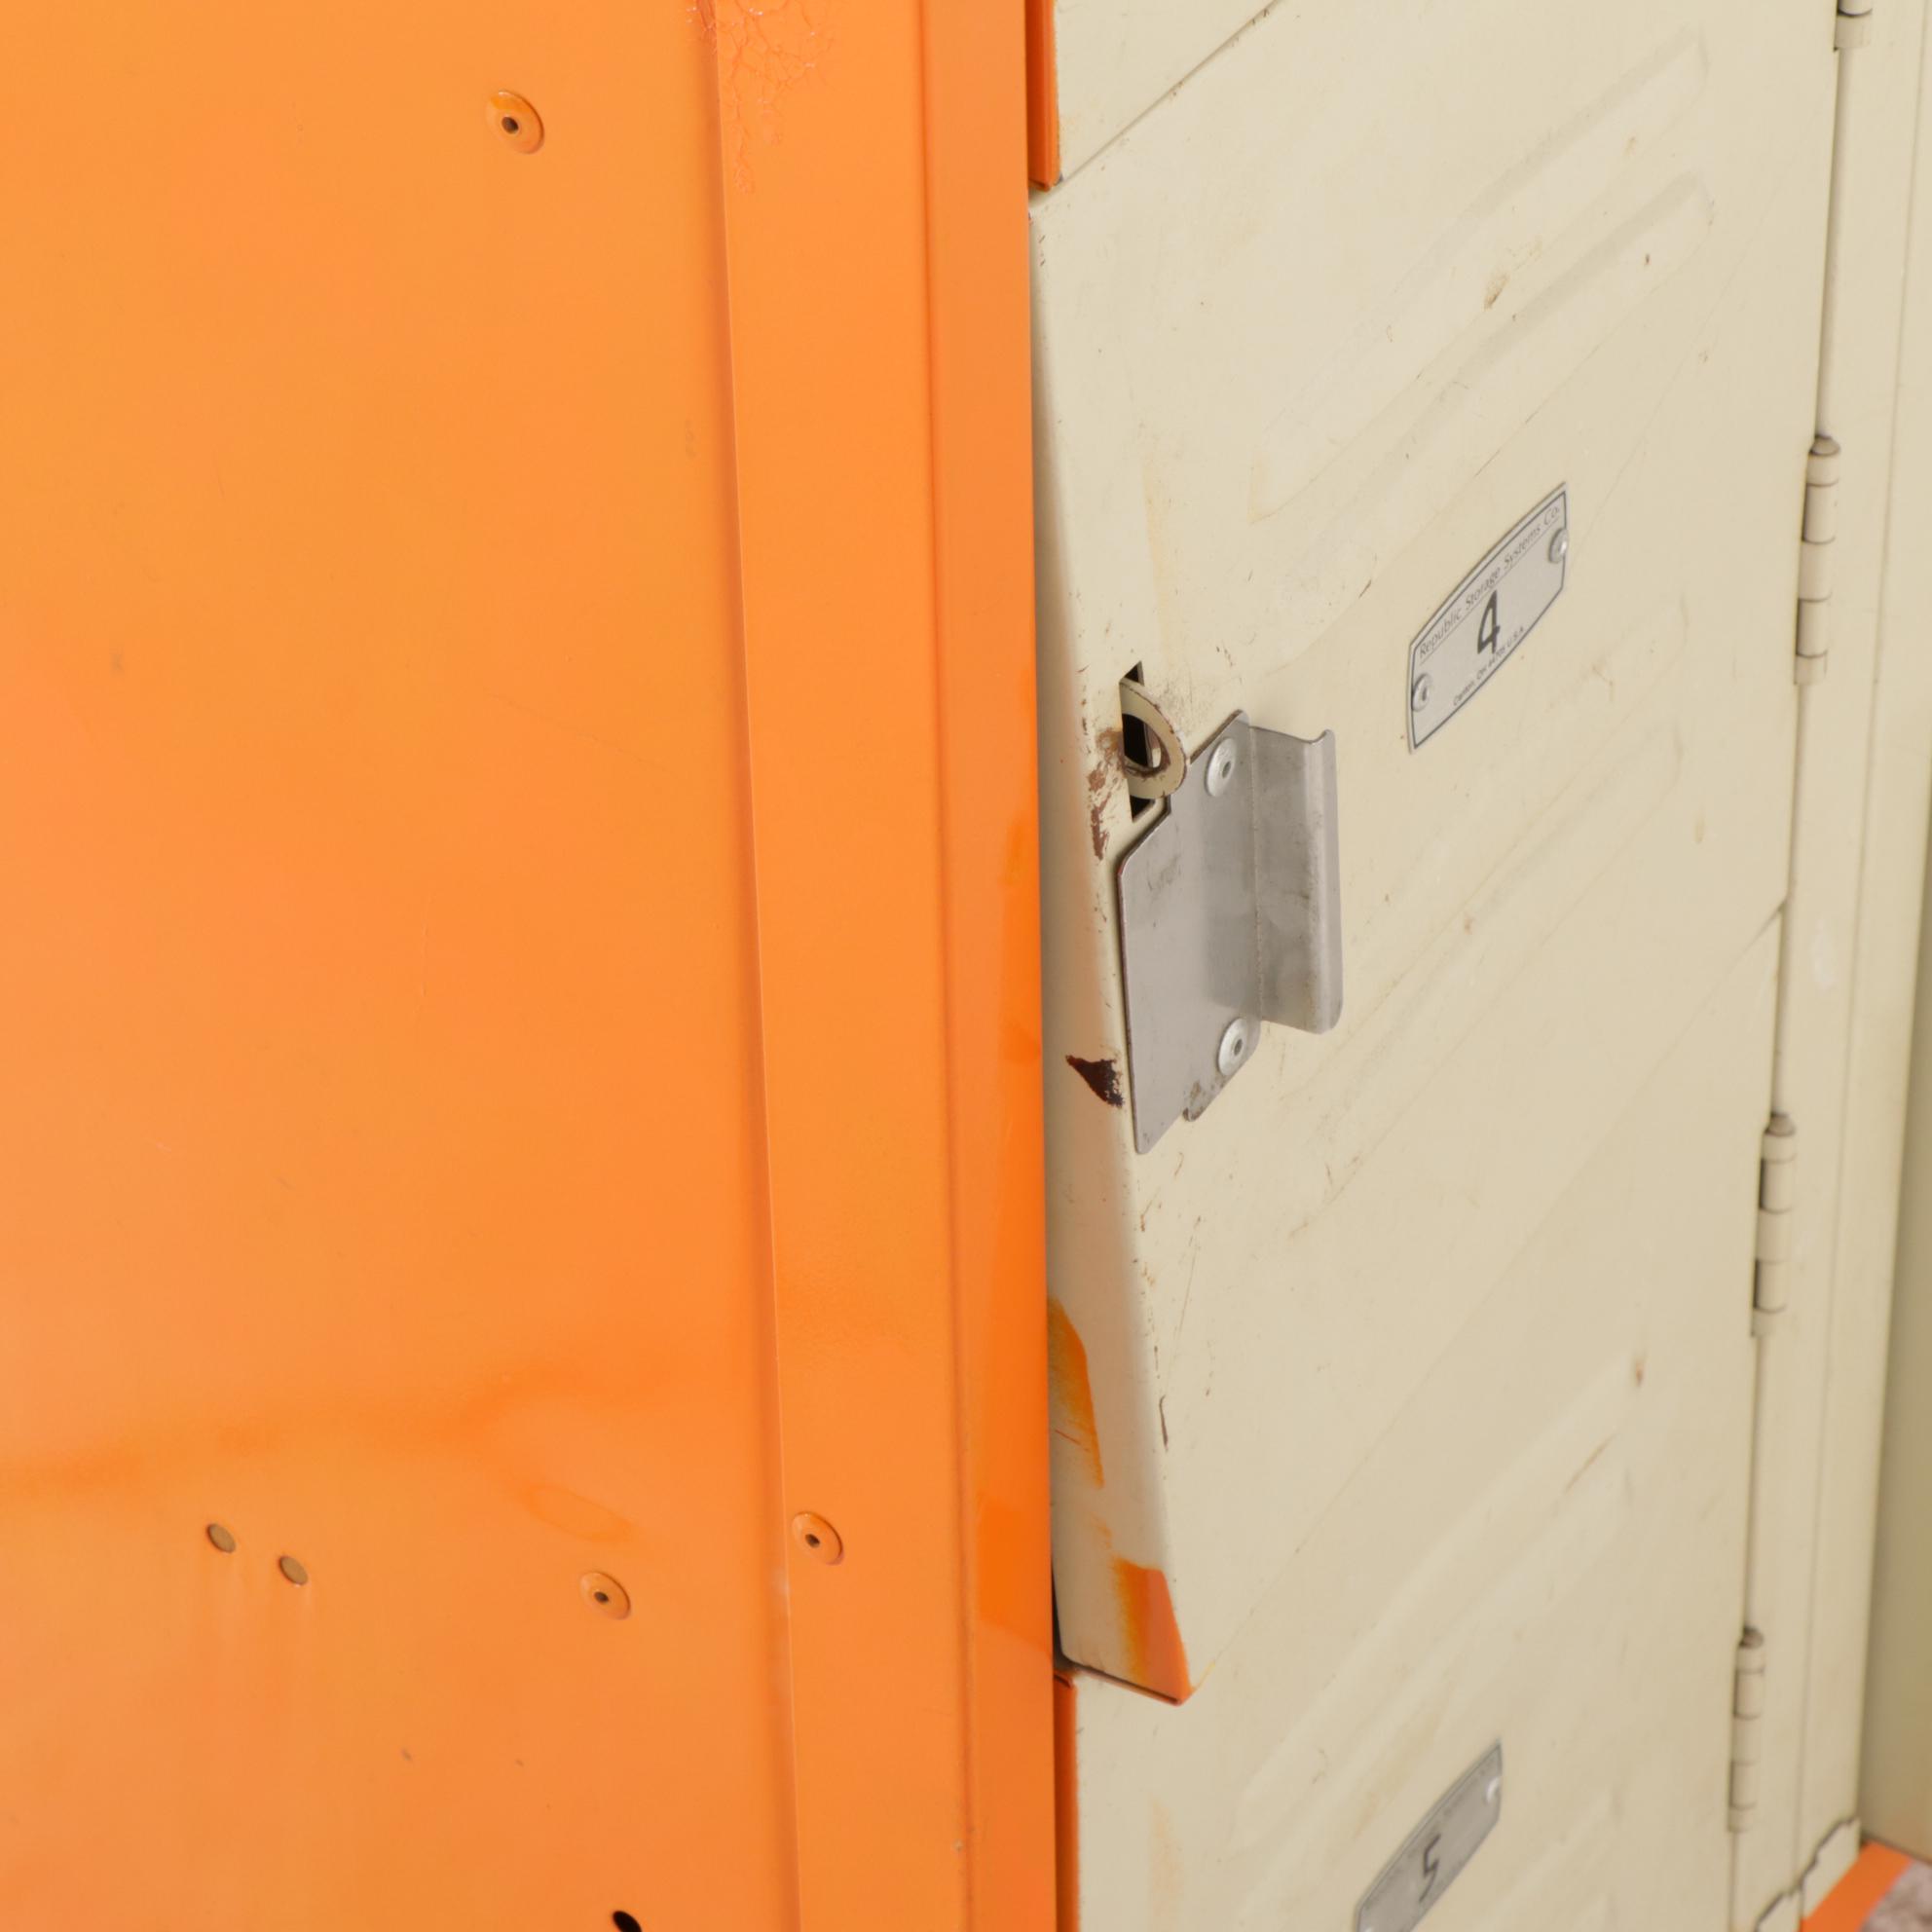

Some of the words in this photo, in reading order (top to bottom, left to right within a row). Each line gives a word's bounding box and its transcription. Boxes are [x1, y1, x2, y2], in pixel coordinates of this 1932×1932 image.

[1420, 607, 1462, 657] Republic
[1466, 567, 1501, 611] Storage
[1504, 527, 1541, 570] Systems
[1477, 589, 1501, 654] 4
[1419, 1833, 1441, 1904] 5
